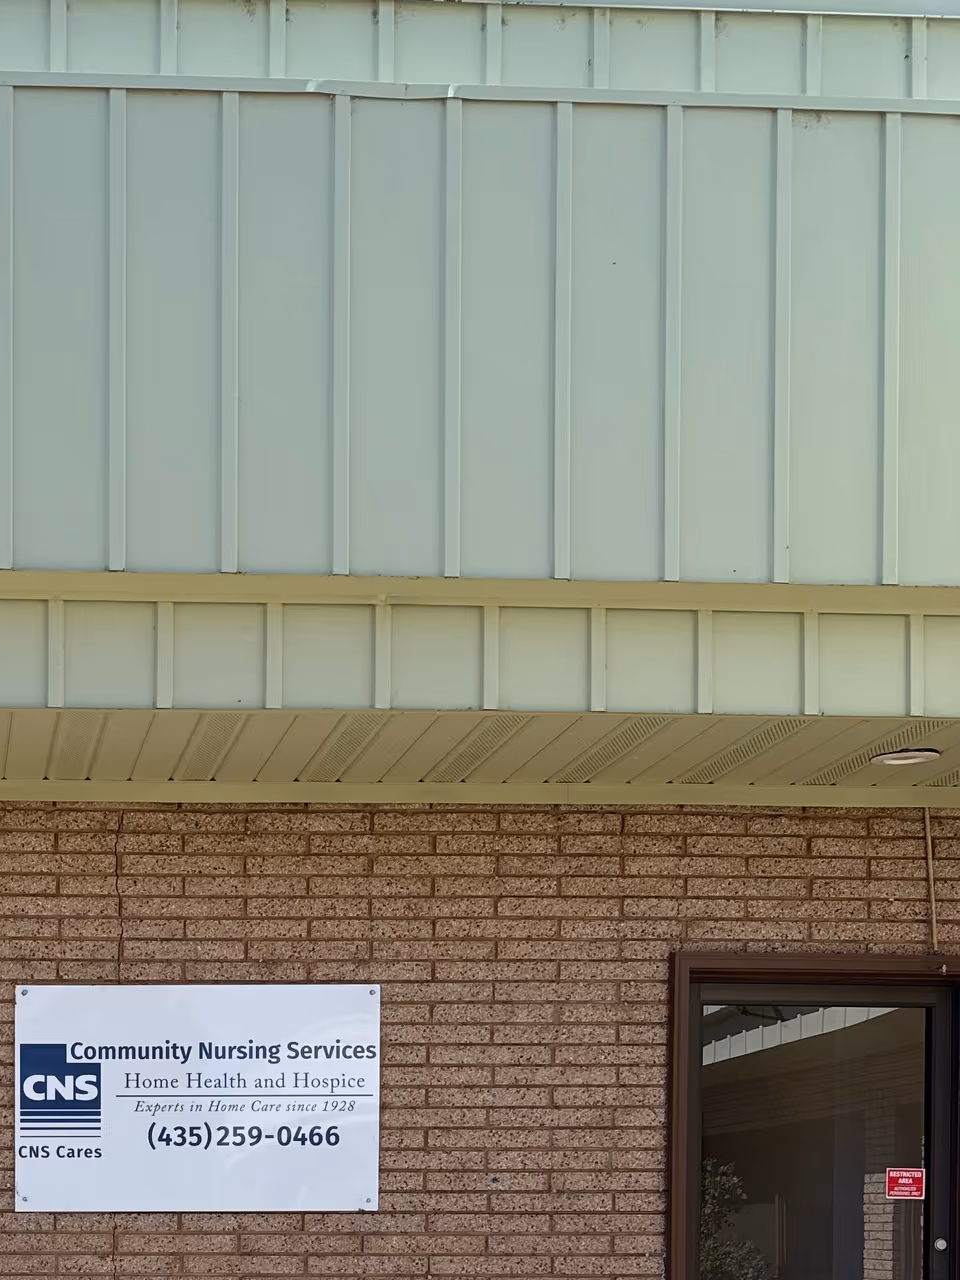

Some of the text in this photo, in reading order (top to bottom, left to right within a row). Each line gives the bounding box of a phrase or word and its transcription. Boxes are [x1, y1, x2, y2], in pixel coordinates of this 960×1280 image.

[71, 1039, 376, 1064] Community Nursing Services
[23, 1075, 98, 1100] CNS
[125, 1073, 364, 1093] Home Health and Hospice
[134, 1100, 355, 1116] Experts in Home Care since 1928
[19, 1146, 101, 1158] CNS Cares
